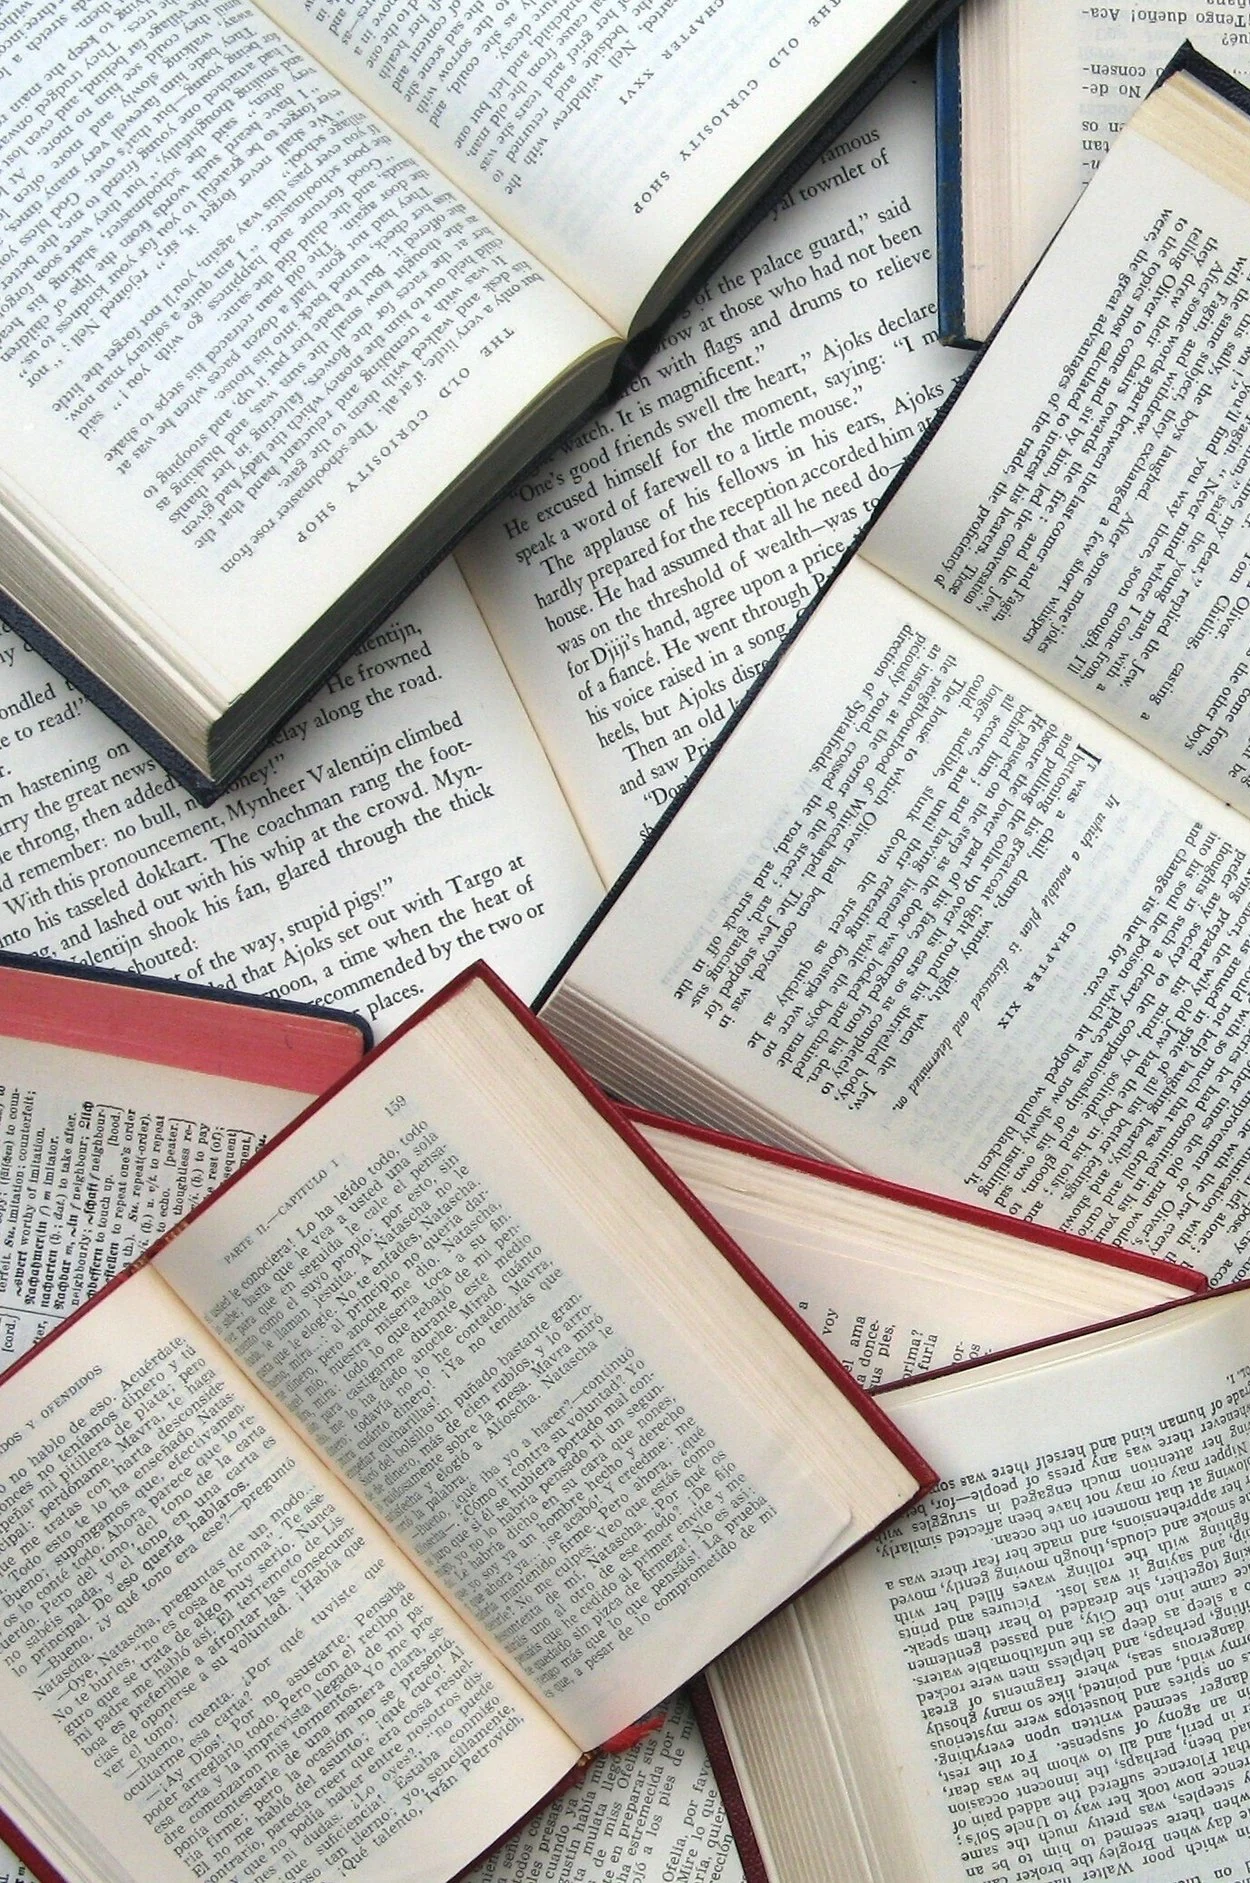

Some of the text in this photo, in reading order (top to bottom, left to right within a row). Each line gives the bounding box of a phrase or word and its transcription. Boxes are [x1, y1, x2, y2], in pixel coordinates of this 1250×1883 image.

[618, 0, 724, 105] CHAPTER XXVI
[632, 0, 841, 214] THE OLD CURIOSITY SHOP
[695, 195, 912, 306] of the palace guard,” said
[655, 248, 933, 379] with flags and drums to relieve
[615, 343, 765, 427] It is magnificent.”
[219, 272, 545, 573] but only a very little, if at all. The schoolmaster rose from
[296, 327, 515, 543] THE OLD CURIOSITY SHOP
[313, 664, 443, 728] along the road.
[2, 709, 464, 915] With this pronouncement, Mynheer Valentijn climbed
[186, 876, 393, 980] of the way, stupid pigs!”
[891, 793, 1120, 1111] In which a notable plan is discussed and determined on.
[366, 983, 424, 1022] places.
[996, 921, 1076, 1030] CHAPTER XIX
[384, 1094, 407, 1117] 159
[20, 1127, 46, 1246] worthy of imitation.
[57, 1112, 77, 1189] to take after.
[94, 1174, 115, 1243] to touch up.
[822, 1308, 839, 1335] voy
[850, 1316, 866, 1347] ama
[24, 1364, 103, 1430] Y OFENDIDOS
[1105, 1527, 1157, 1550] clouds,
[1160, 1517, 1189, 1537] and
[1192, 1499, 1236, 1523] smoke
[940, 1570, 990, 1595] gently,
[993, 1557, 1050, 1580] moving
[1052, 1542, 1105, 1567] though
[241, 1558, 385, 1687] ¿Por qué tuviste que
[888, 1587, 937, 1611] moved
